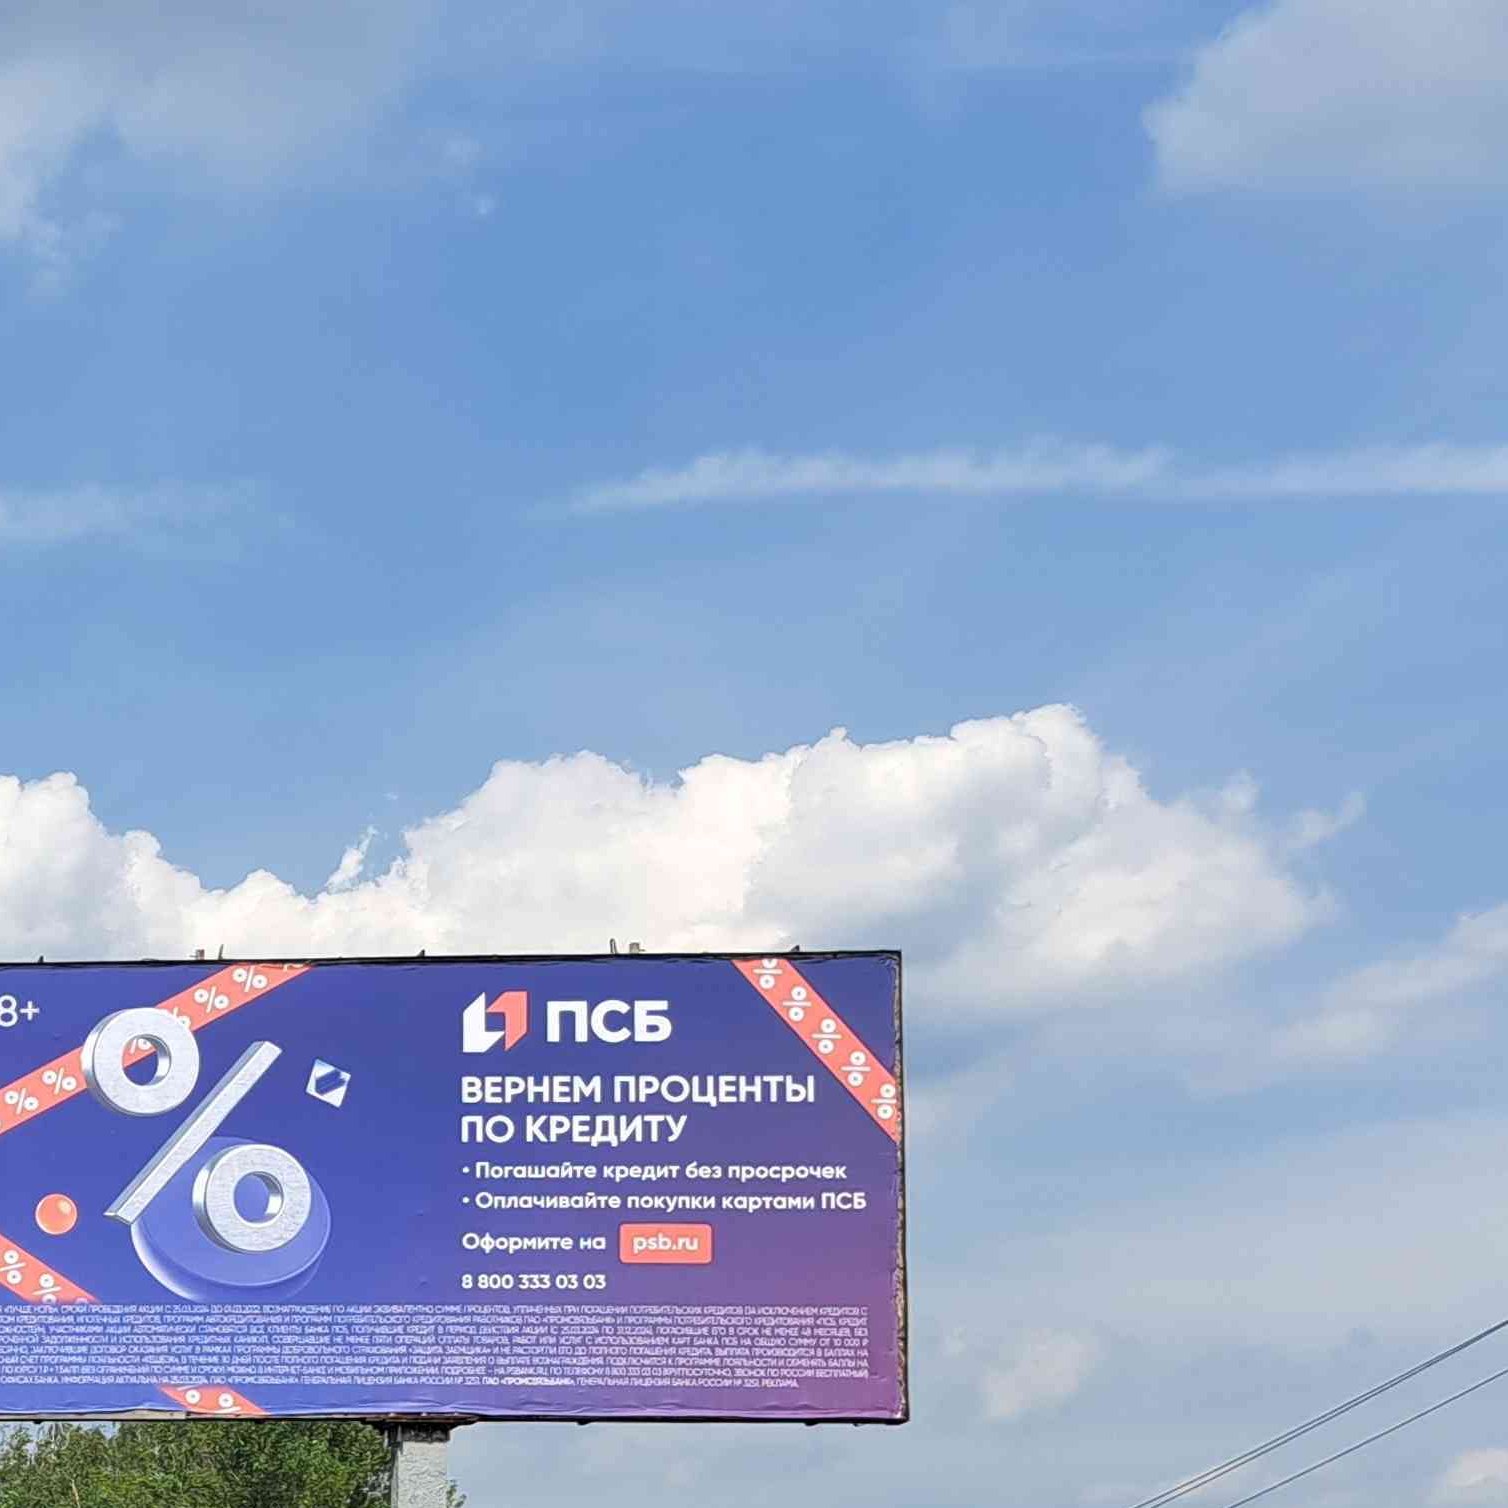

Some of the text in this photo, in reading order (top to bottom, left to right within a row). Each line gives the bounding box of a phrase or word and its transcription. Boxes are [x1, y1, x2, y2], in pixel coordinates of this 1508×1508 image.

[546, 999, 673, 1043] ПСБ
[461, 1074, 815, 1107] ВЕРНЕМ ПРОЦЕНТЫ
[81, 1007, 311, 1252] %
[460, 1114, 687, 1147] ПО КРЕДИТУ
[475, 1161, 847, 1183] Погашайте кредит без просрочек
[475, 1191, 867, 1213] Оплачивайте покупки картами ПСБ
[462, 1233, 606, 1253] Оформите на
[632, 1233, 699, 1253] psb.ru
[461, 1274, 607, 1290] 8 800 333 03 03
